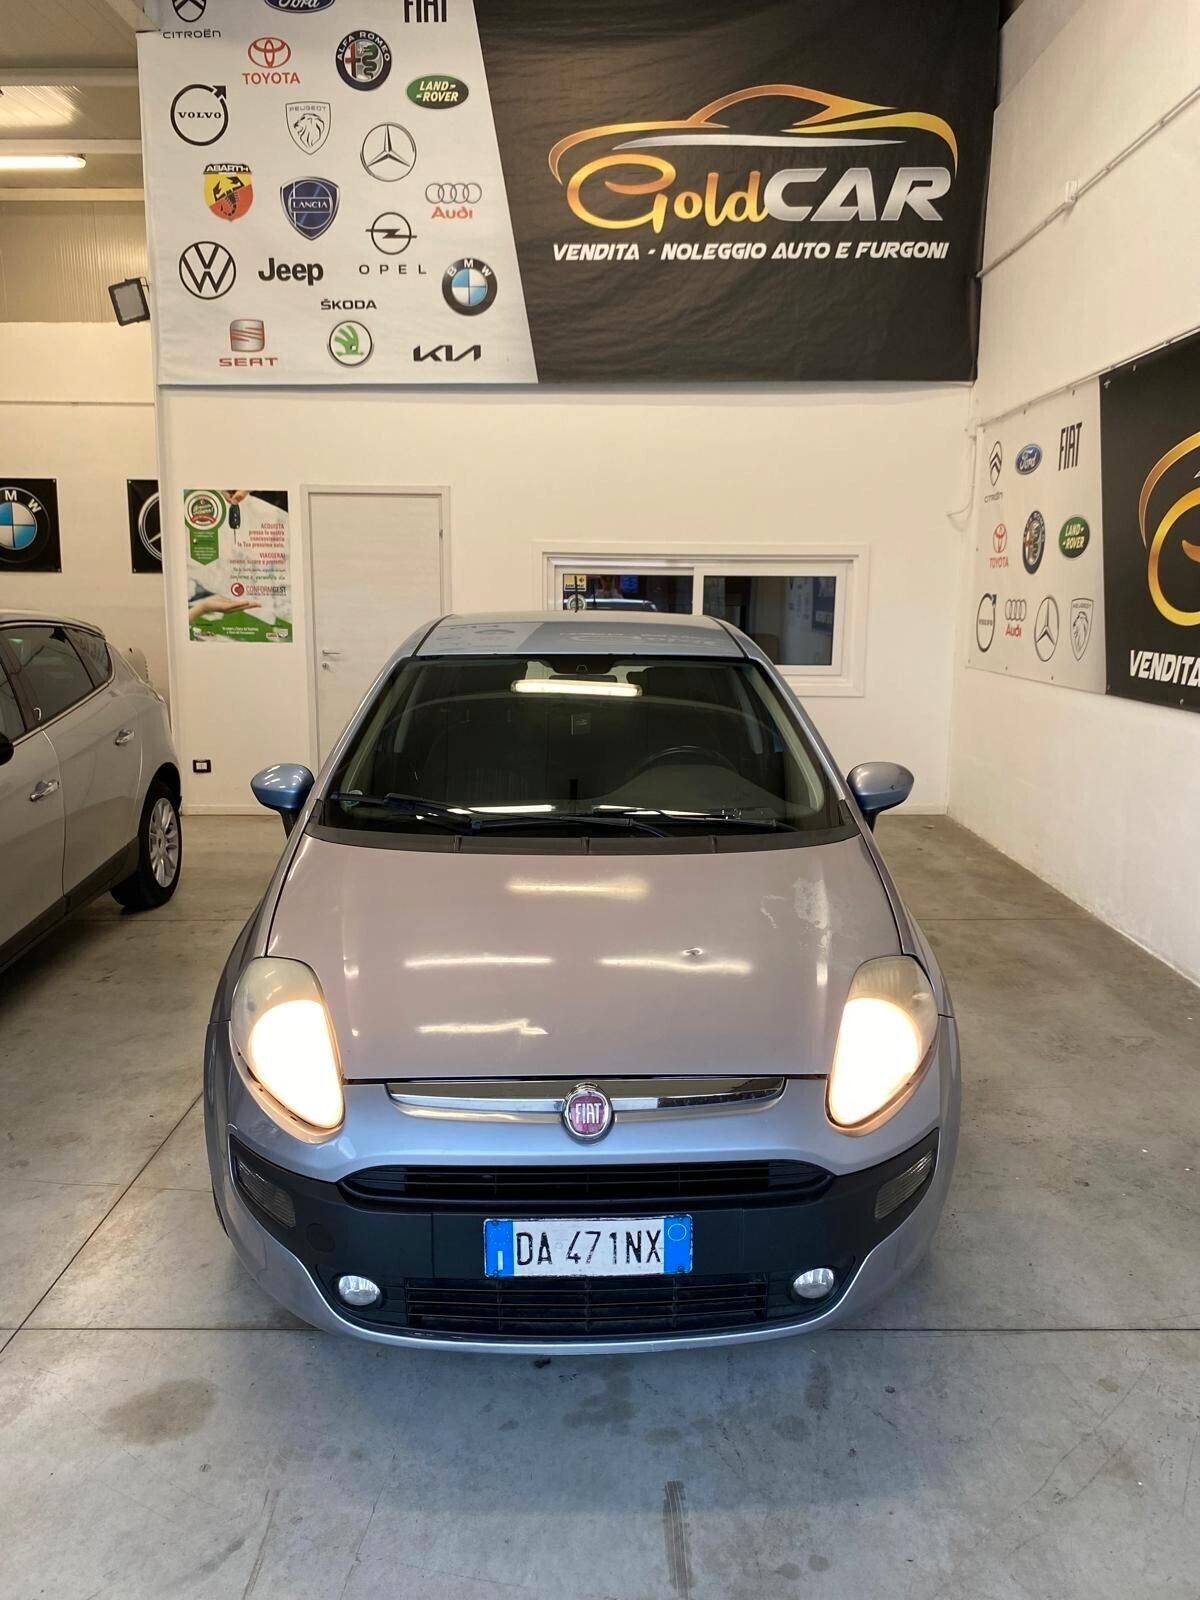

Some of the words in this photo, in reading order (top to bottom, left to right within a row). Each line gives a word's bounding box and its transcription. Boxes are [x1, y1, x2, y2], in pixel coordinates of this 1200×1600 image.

[337, 35, 355, 61] ALFA
[359, 31, 390, 62] ROMEO
[242, 72, 300, 85] TOYOTA
[177, 111, 222, 119] VOLVO
[206, 164, 249, 173] ABARTH
[292, 201, 329, 209] LANCIA
[432, 206, 473, 219] Audi
[553, 243, 640, 261] VENDITA
[660, 242, 767, 260] NOLEGGIO
[771, 242, 830, 259] AUTO
[835, 242, 850, 258] E
[855, 241, 950, 259] FURGONI
[258, 258, 324, 286] Jeep
[358, 264, 428, 275] OPEL
[448, 259, 493, 278] BMW
[320, 298, 378, 310] ŠKODA
[219, 358, 279, 367] SEAT
[1058, 421, 1083, 472] FIAT
[989, 556, 1009, 568] TOYOTA
[1005, 624, 1022, 637] Audi
[575, 1103, 601, 1124] FIAT
[516, 1232, 553, 1265] DA
